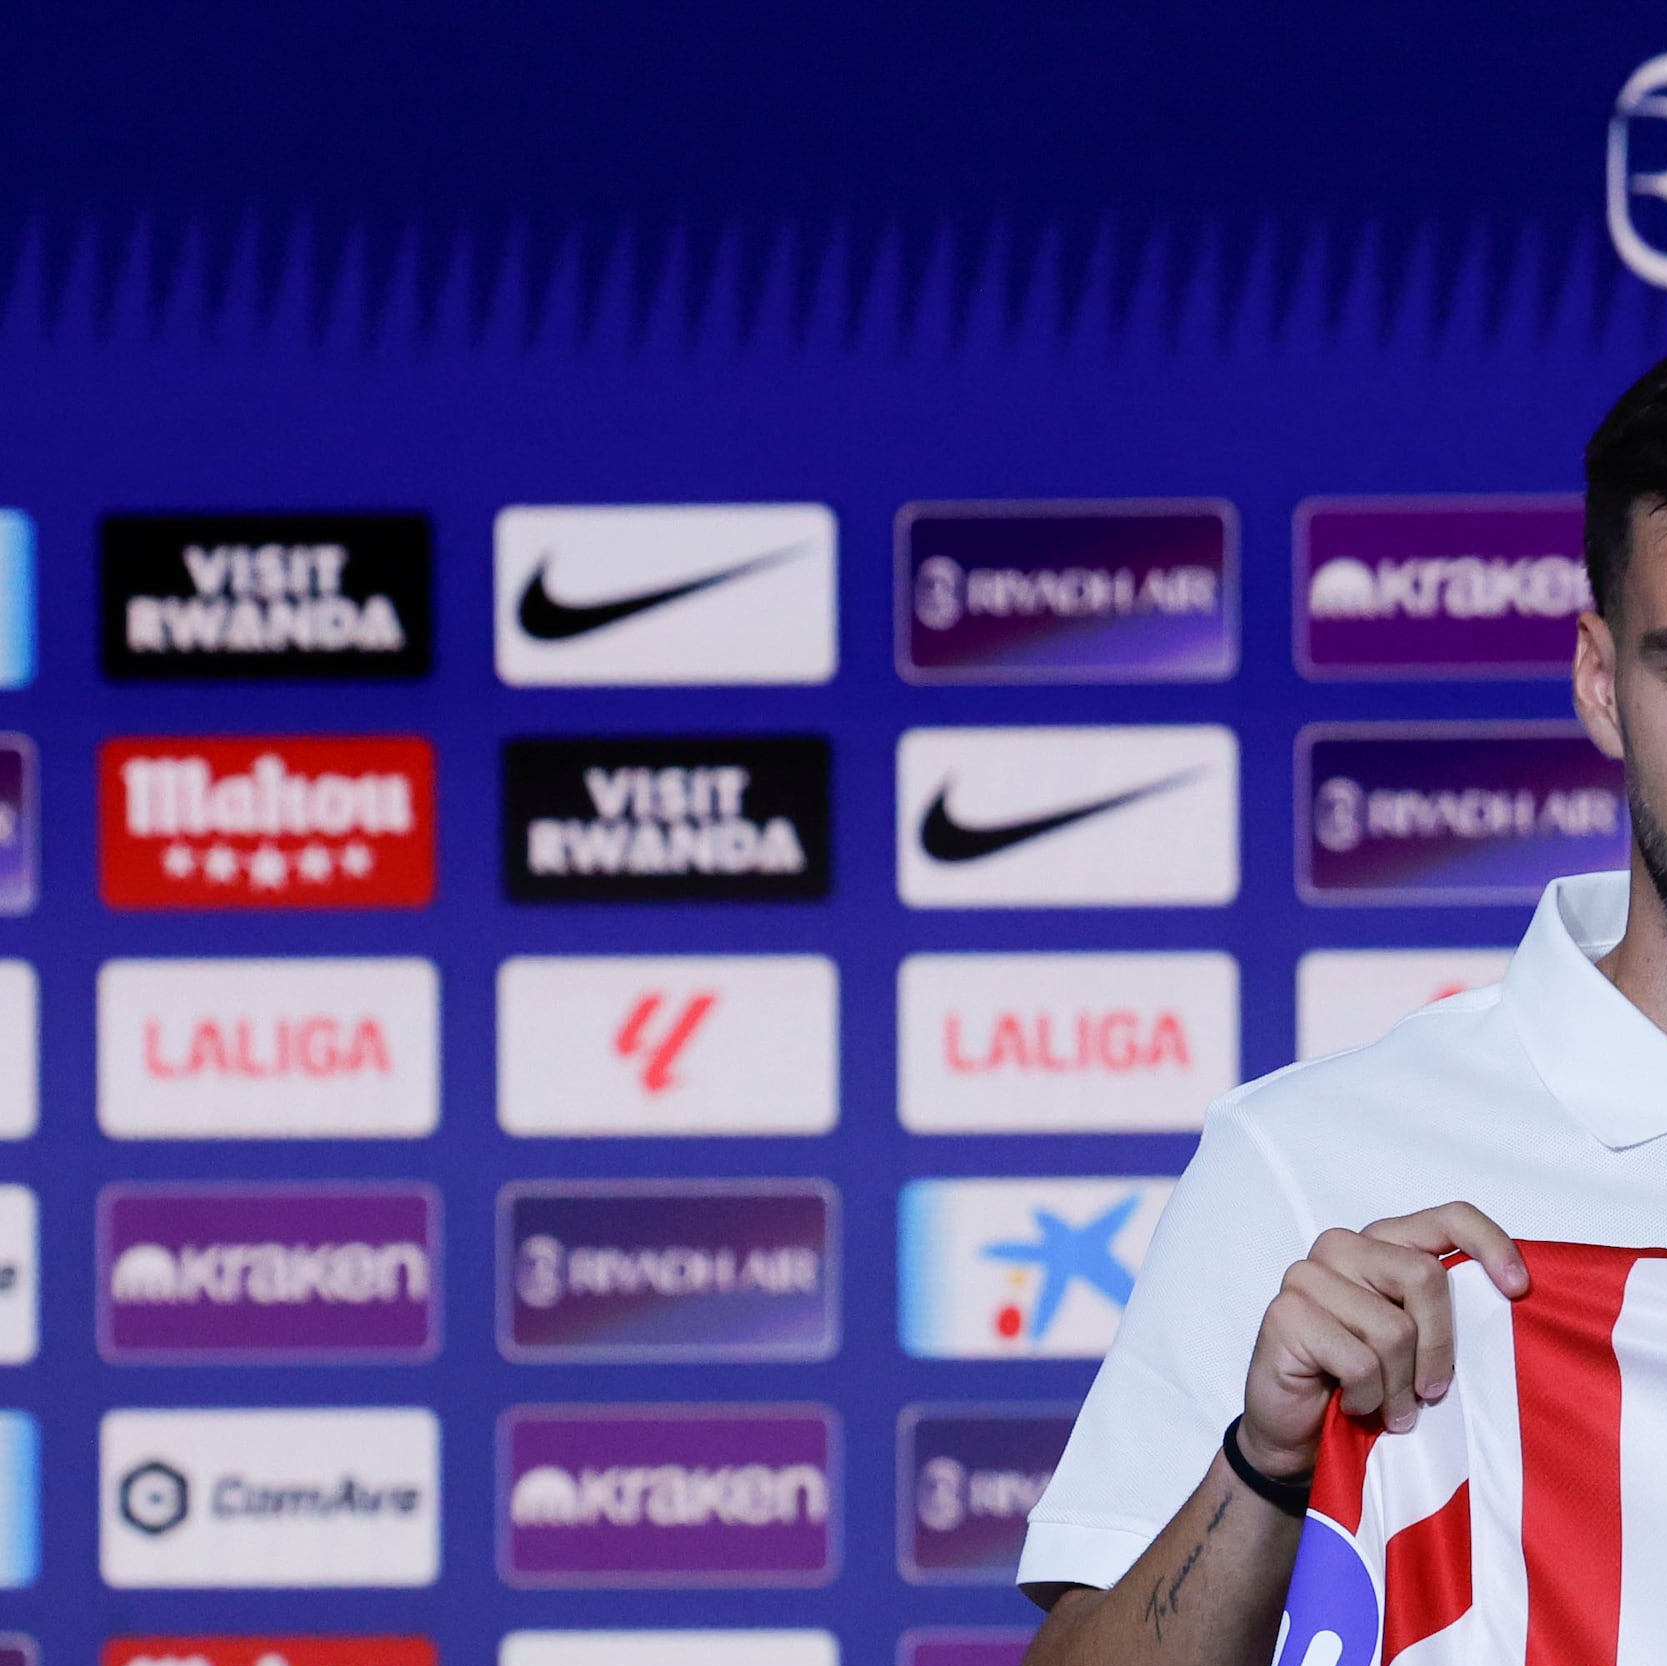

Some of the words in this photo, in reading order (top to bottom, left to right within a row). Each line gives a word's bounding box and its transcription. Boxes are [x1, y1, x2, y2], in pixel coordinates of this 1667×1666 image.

[185, 545, 345, 596] VISIT
[127, 597, 402, 650] RWANDA
[124, 756, 412, 836] Mahou
[586, 767, 746, 818] VISIT
[529, 818, 803, 873] RWANDA
[144, 1016, 391, 1079] LALIGA
[944, 1010, 1191, 1074] LALIGA
